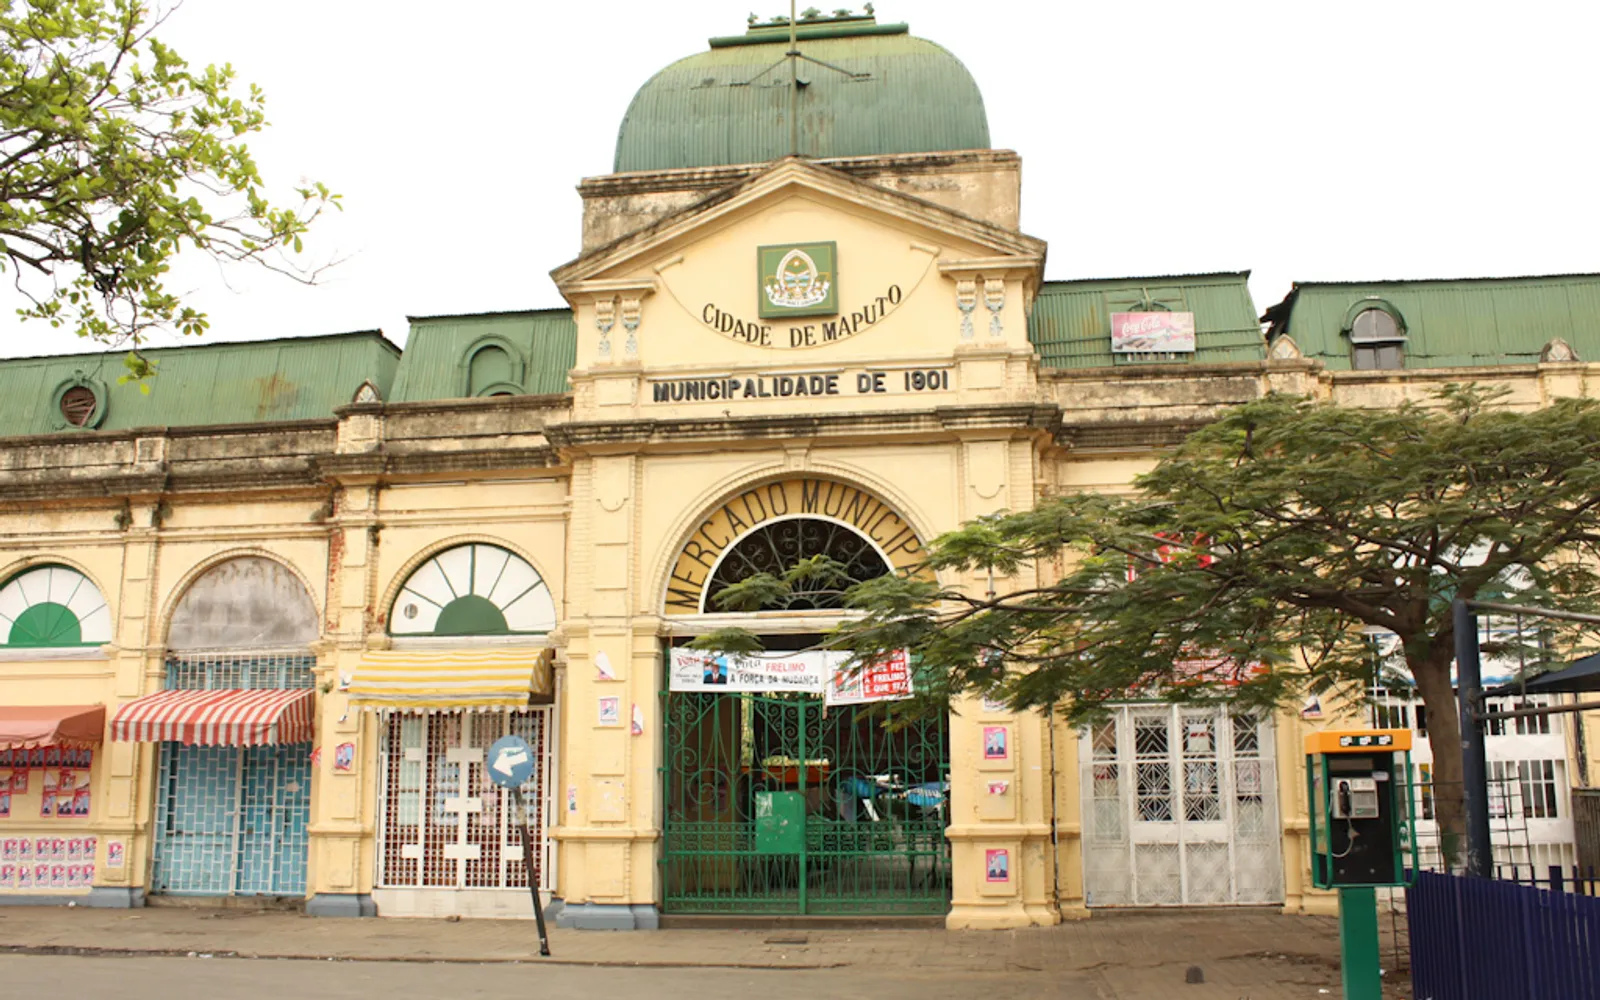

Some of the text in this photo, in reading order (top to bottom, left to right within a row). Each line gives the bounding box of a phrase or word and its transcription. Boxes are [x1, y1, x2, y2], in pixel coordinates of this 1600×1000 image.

[702, 284, 902, 348] CIDADE DE MAPUTO
[653, 370, 948, 403] MUNICIPALIDADE DE 1901
[665, 481, 788, 609] MERCADO
[765, 662, 806, 673] FRELIMO
[890, 661, 905, 671] FEZ
[730, 673, 736, 683] A
[864, 672, 906, 684] A FRELIMO
[874, 683, 889, 693] QUE
